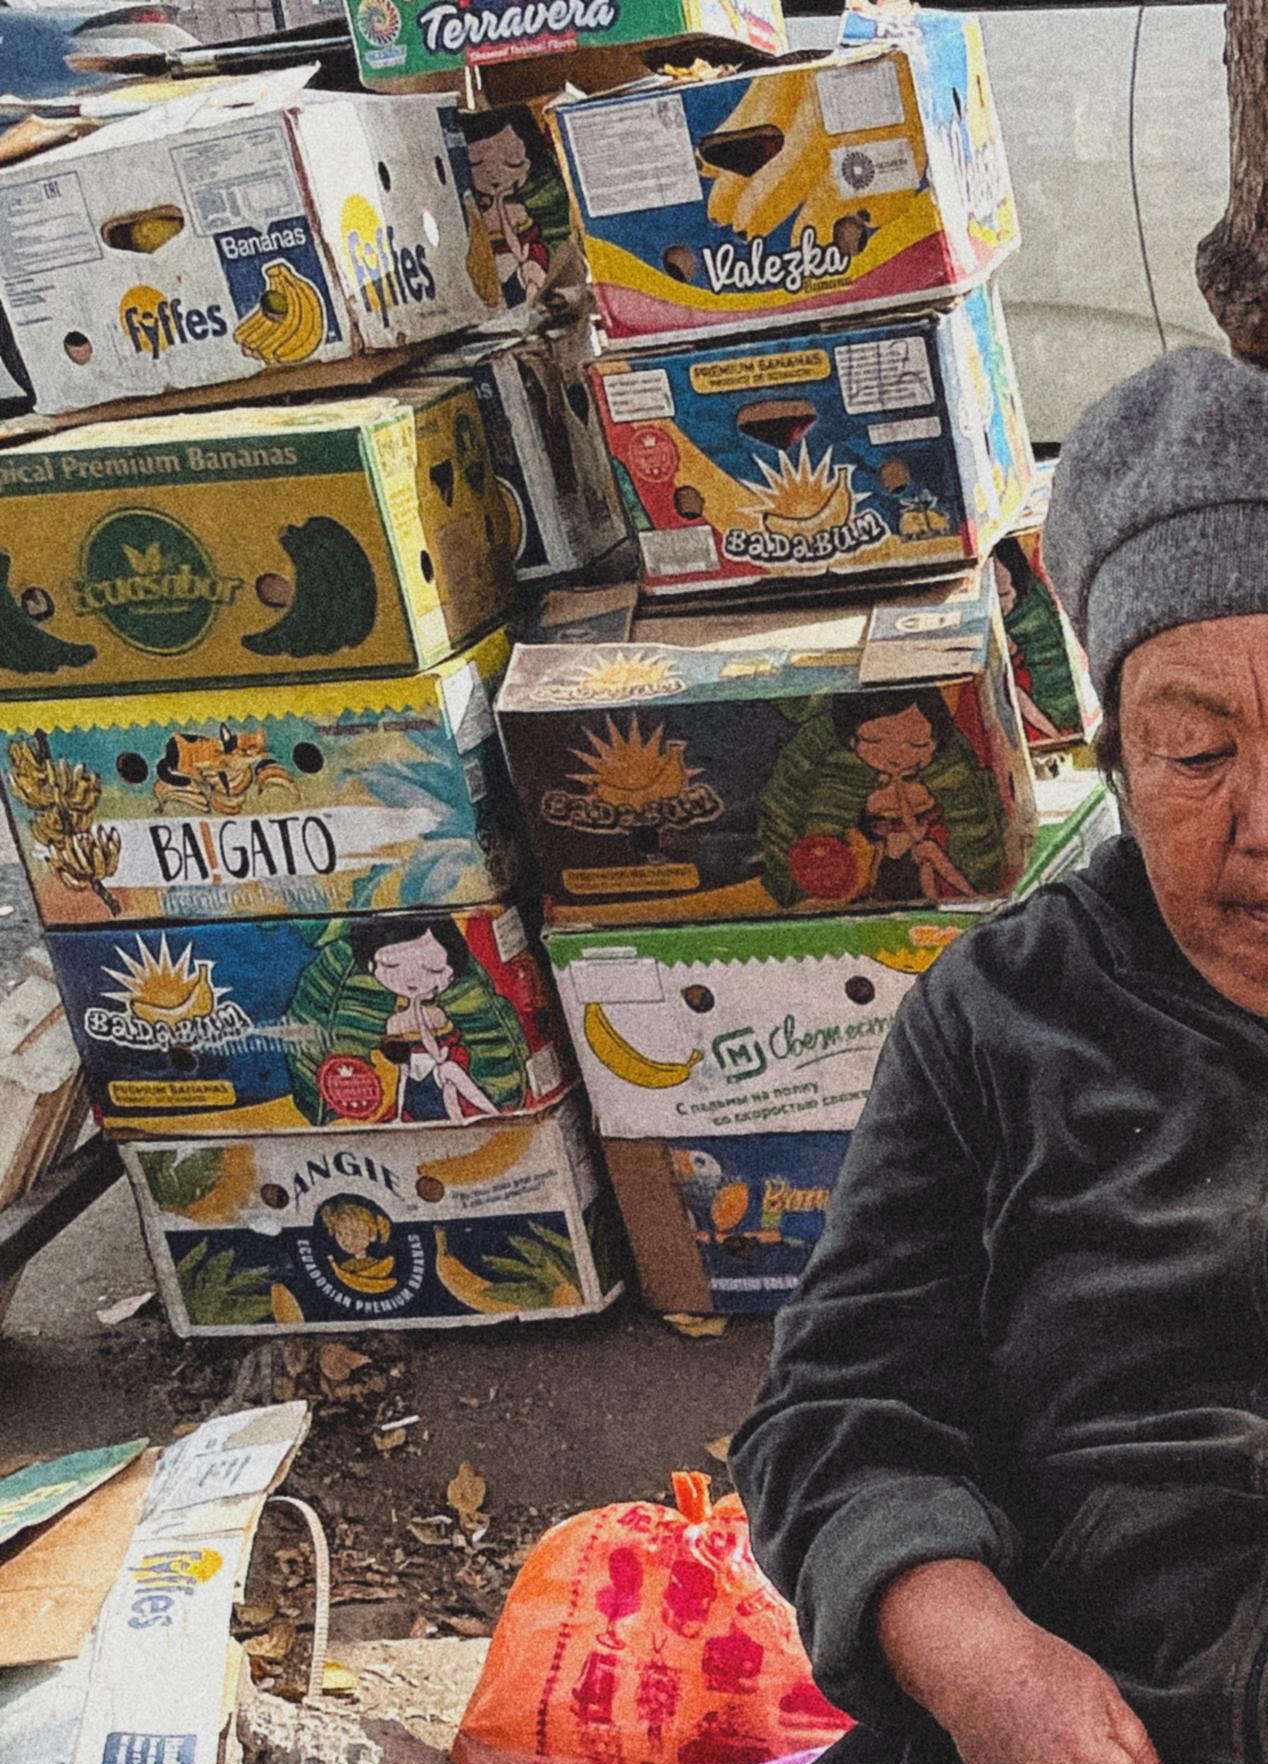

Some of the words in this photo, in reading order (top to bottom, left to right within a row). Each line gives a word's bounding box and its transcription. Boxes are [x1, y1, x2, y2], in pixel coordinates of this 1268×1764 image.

[420, 0, 615, 51] Terravera
[223, 227, 306, 259] Bananas
[703, 228, 851, 295] Valezka
[348, 225, 436, 328] fyffes
[123, 300, 228, 359] fyffes
[61, 448, 181, 480] Premium
[188, 443, 298, 471] Bananas
[752, 1091, 770, 1103] на
[292, 1151, 405, 1213] ANGIE
[297, 1239, 352, 1308] ECUADORIAN
[355, 1287, 414, 1314] PREMIUM
[407, 1233, 425, 1291] BANANAS
[128, 1548, 203, 1630] fyffes
